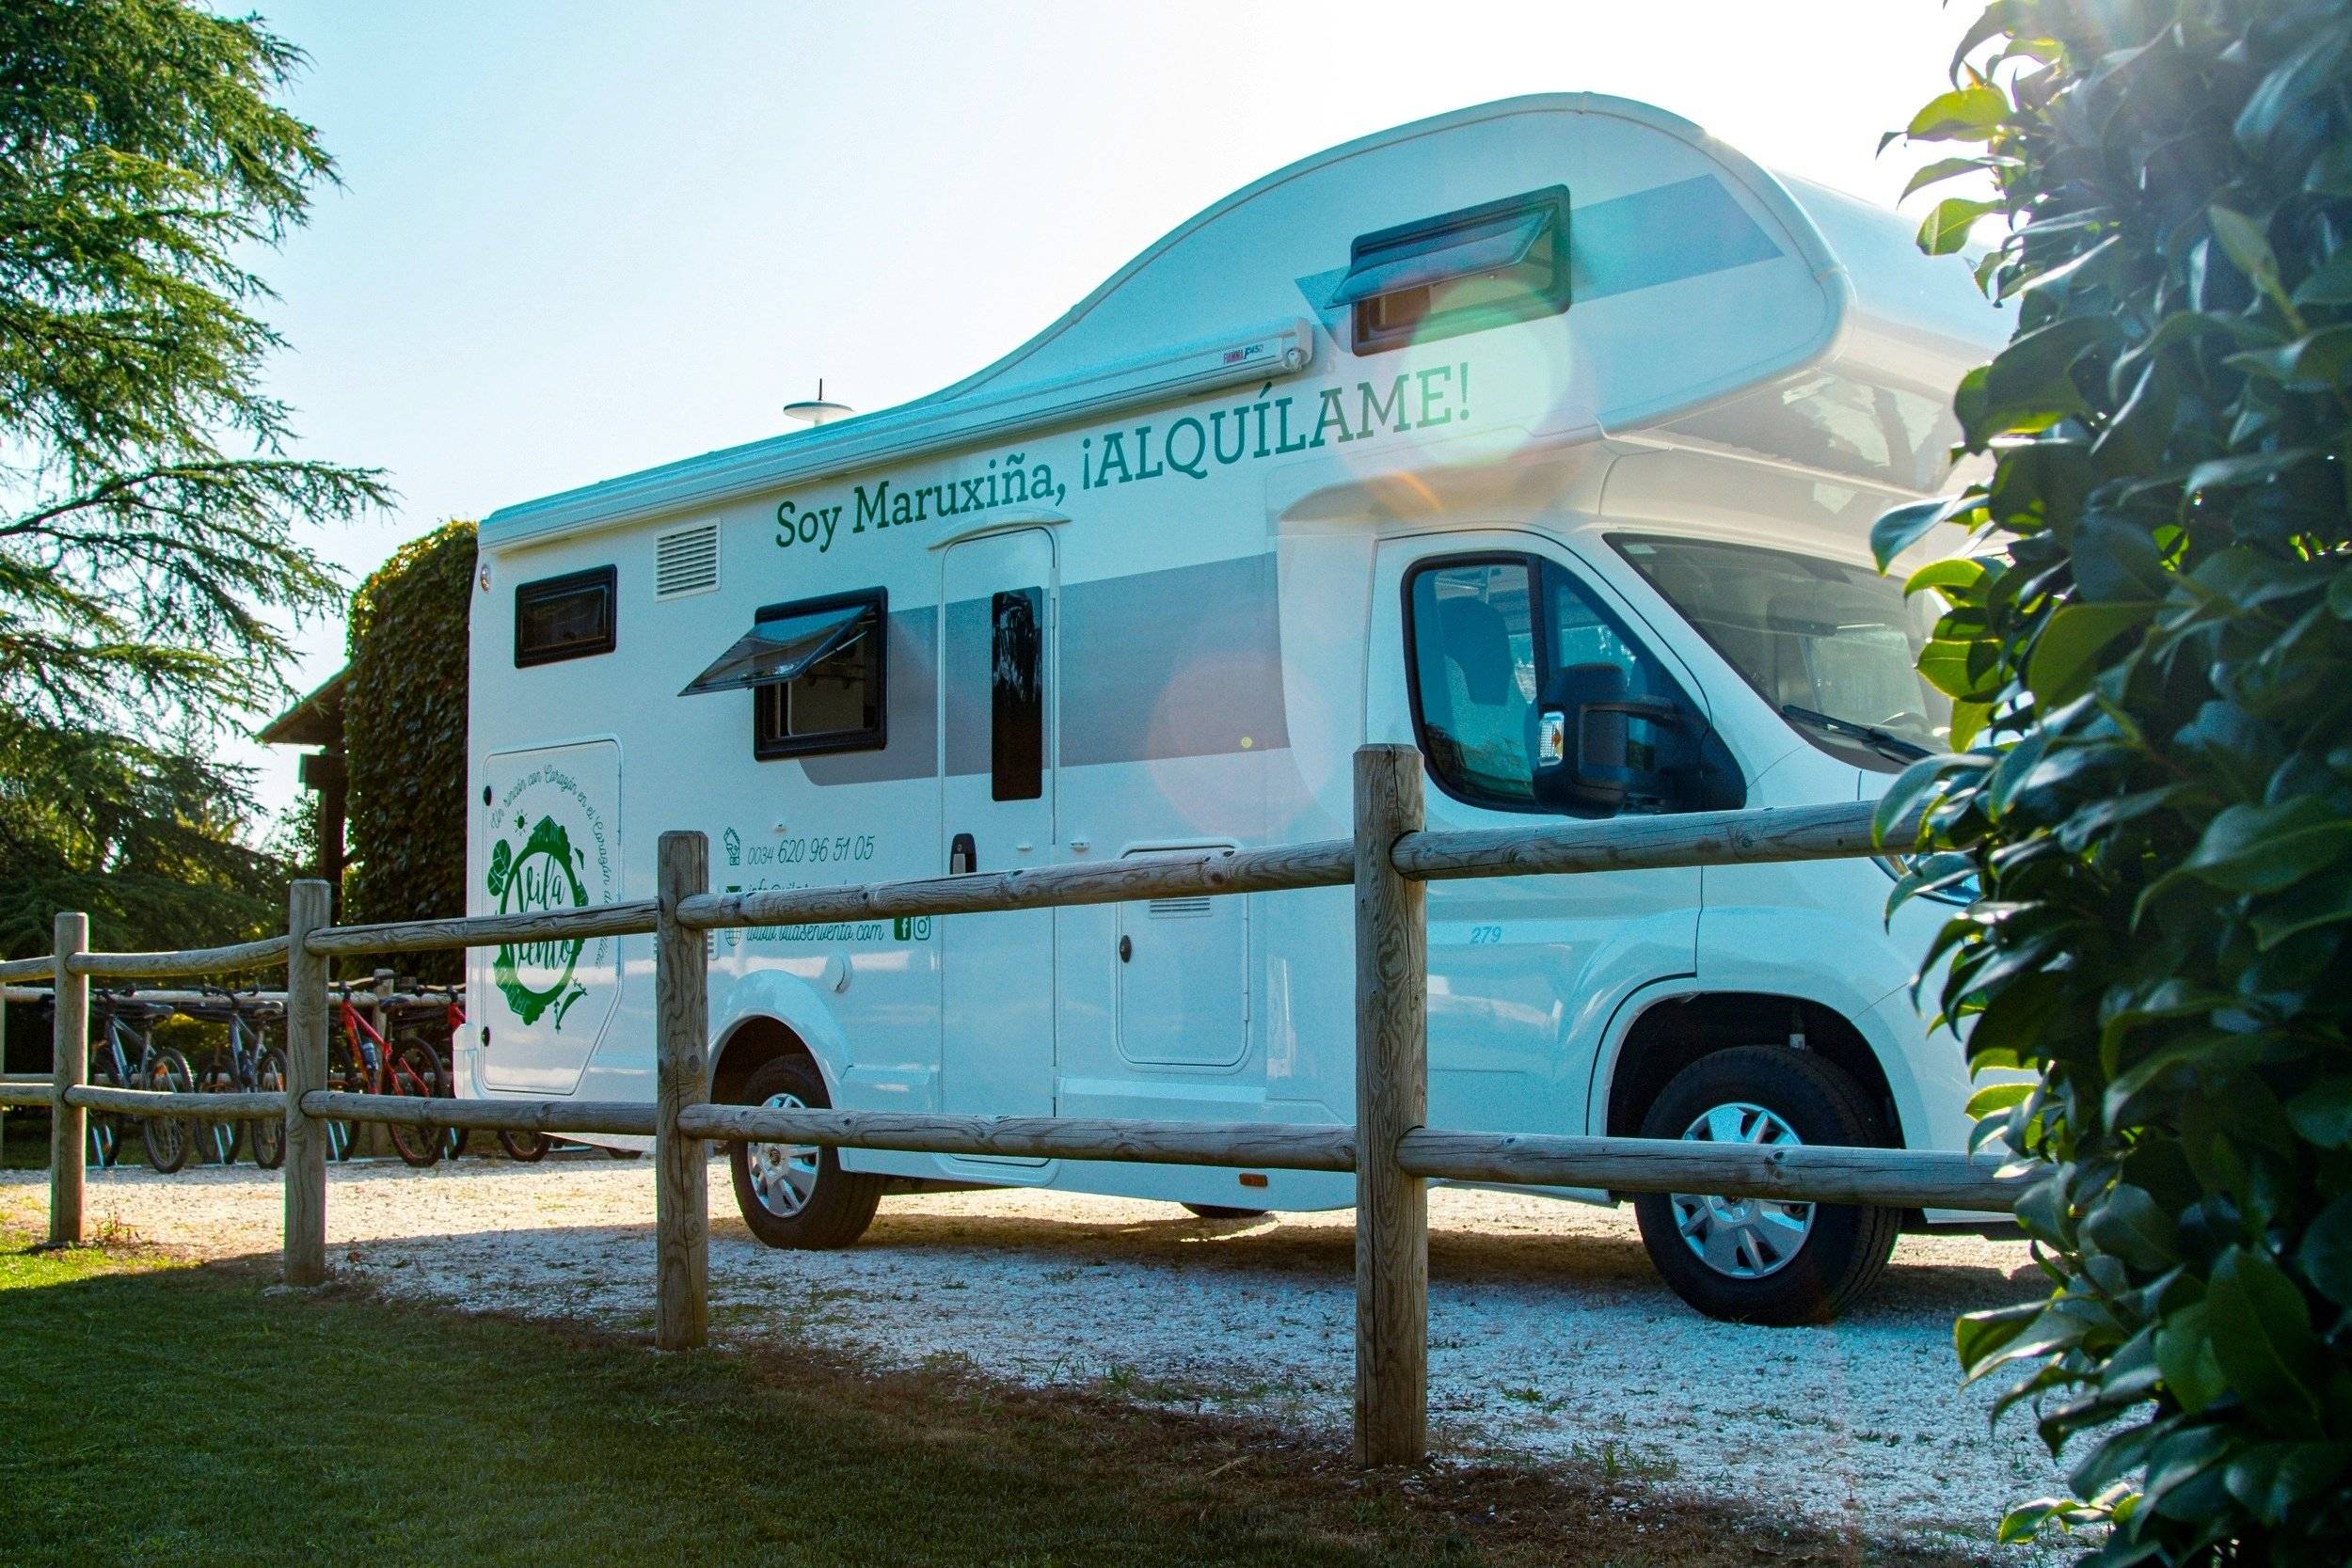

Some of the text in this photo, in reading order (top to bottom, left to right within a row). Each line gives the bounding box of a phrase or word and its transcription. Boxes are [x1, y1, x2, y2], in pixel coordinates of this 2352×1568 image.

[776, 361, 1470, 553] Soy Maruxiña, ¡ALQUÍLAME!
[577, 791, 587, 808] en
[585, 806, 596, 820] el
[592, 815, 612, 887] Corazón
[747, 834, 875, 865] 0034 620 96 51 05
[1470, 926, 1502, 944] 279
